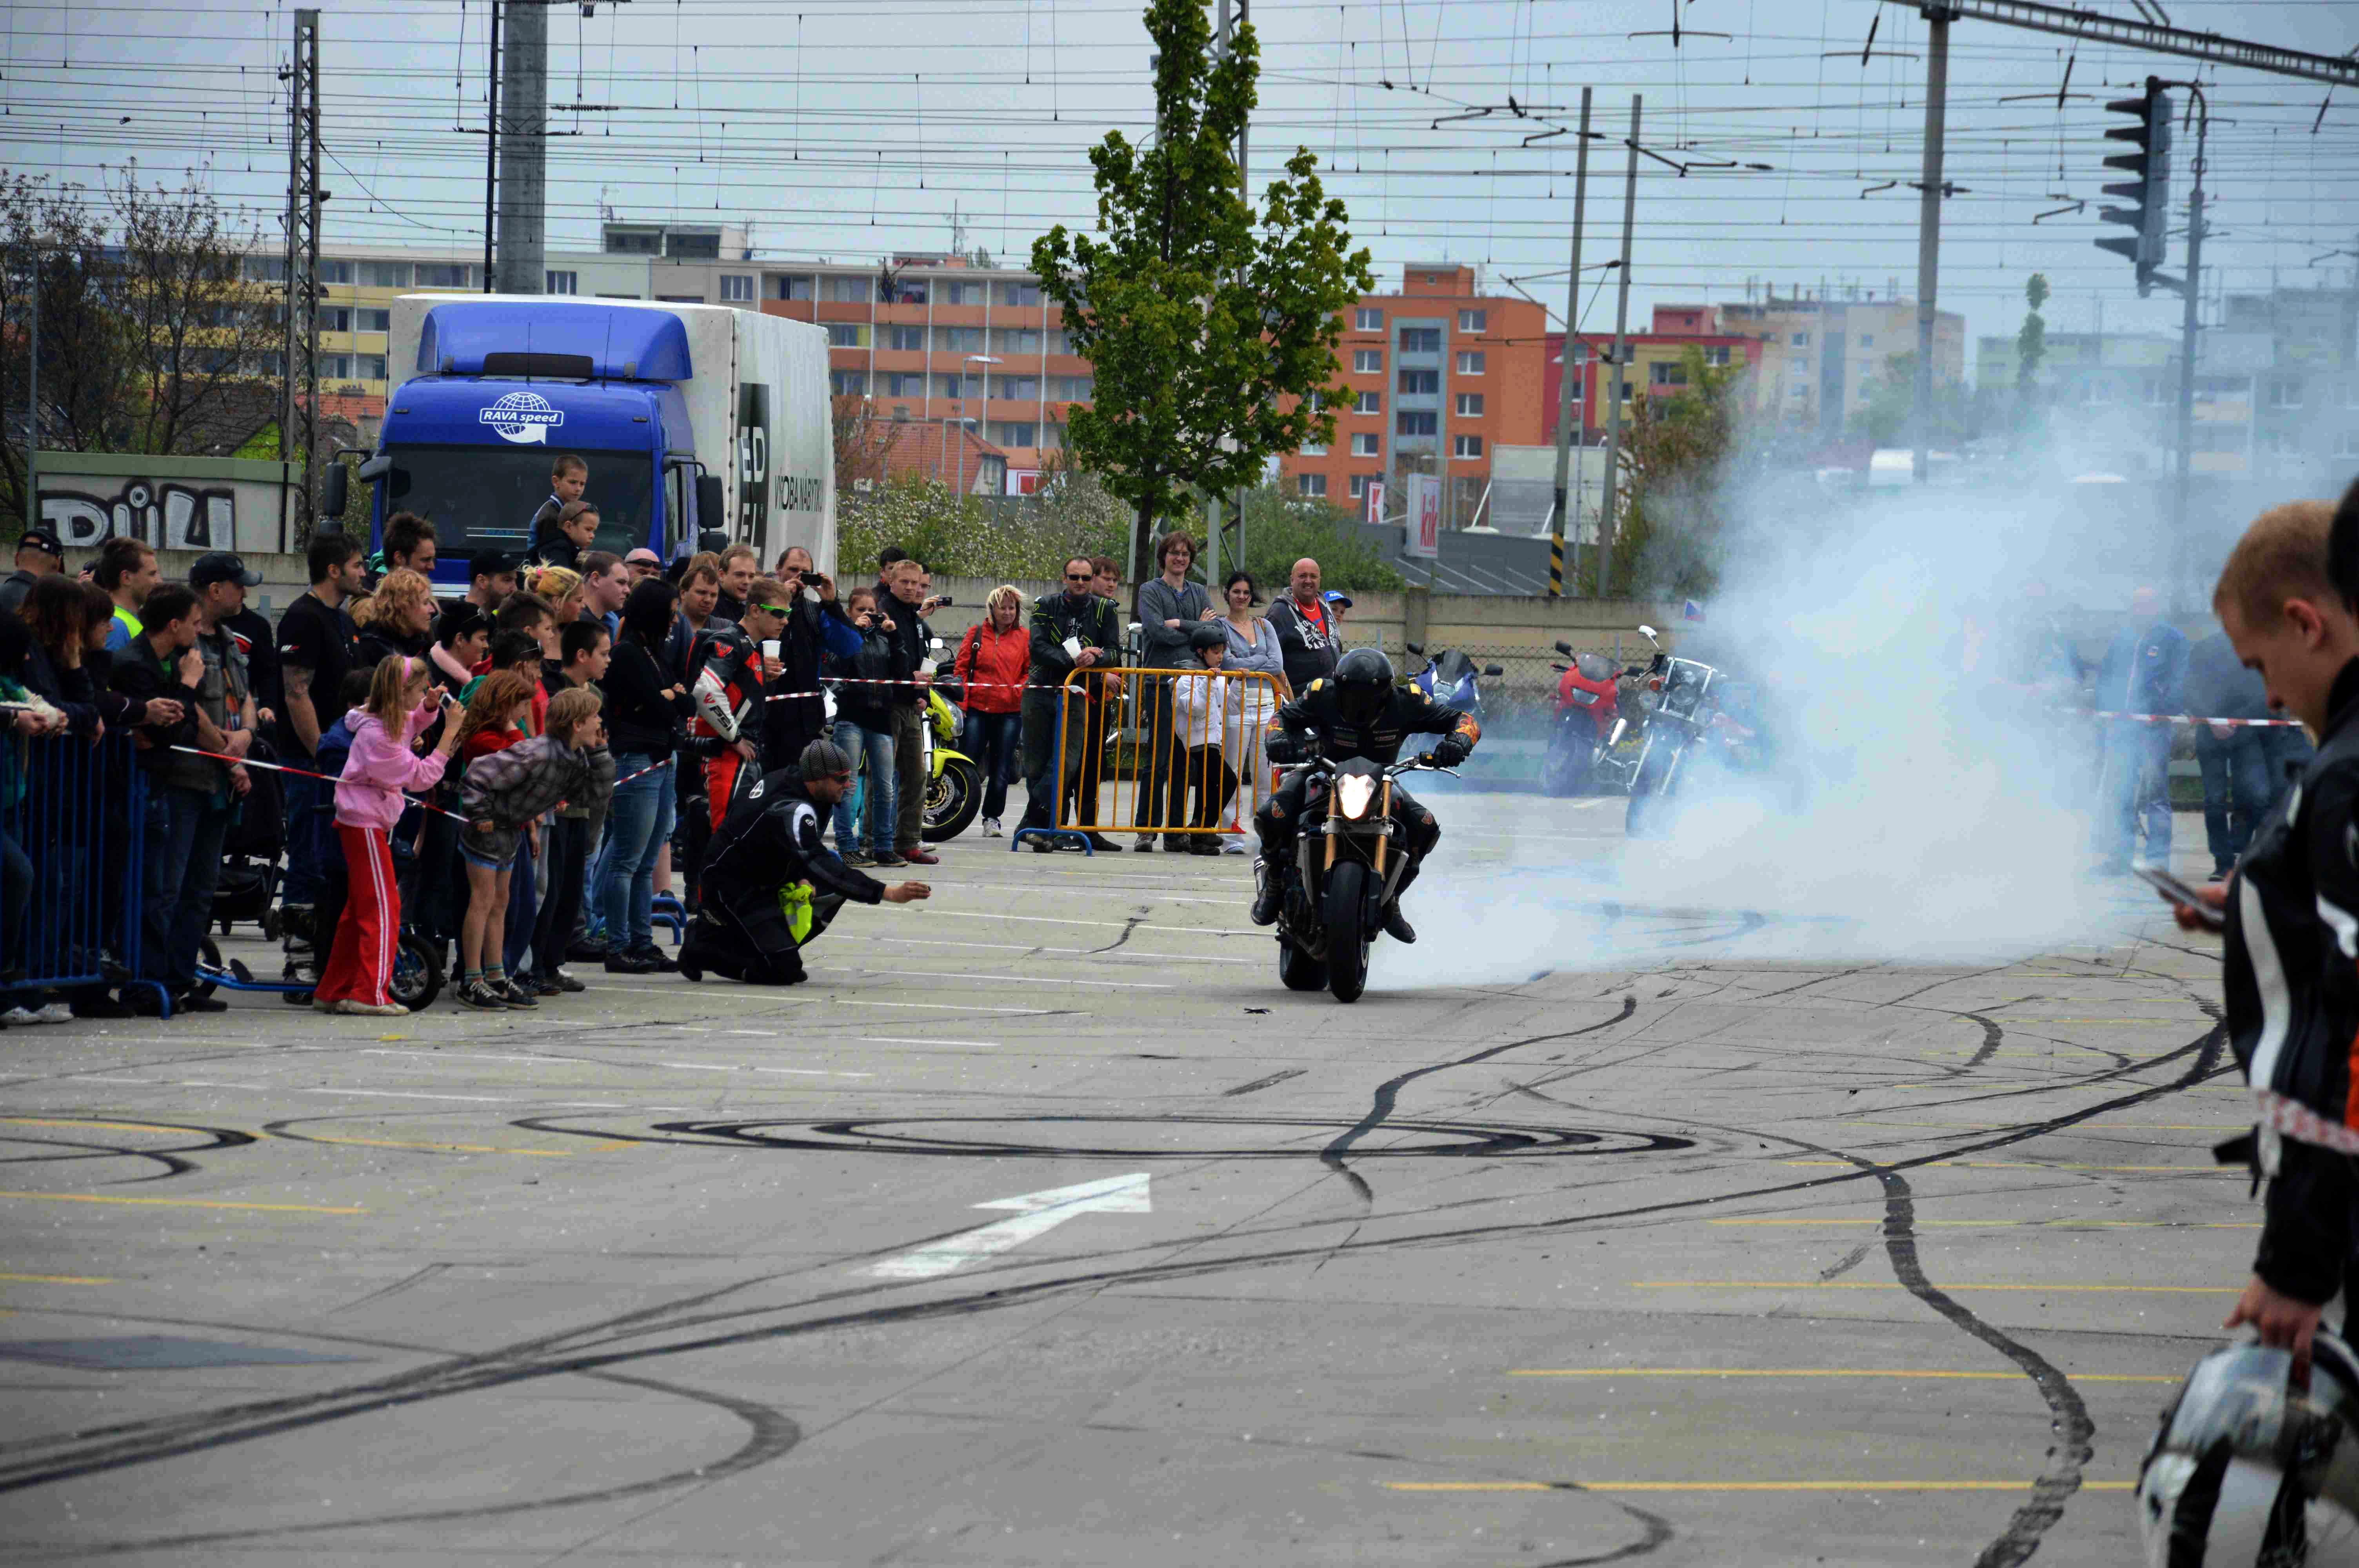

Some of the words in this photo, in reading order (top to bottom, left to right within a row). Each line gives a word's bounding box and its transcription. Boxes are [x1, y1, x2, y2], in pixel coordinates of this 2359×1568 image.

[483, 411, 517, 421] RAVA
[520, 414, 558, 423] speed
[800, 469, 822, 513] NÁBYTKU
